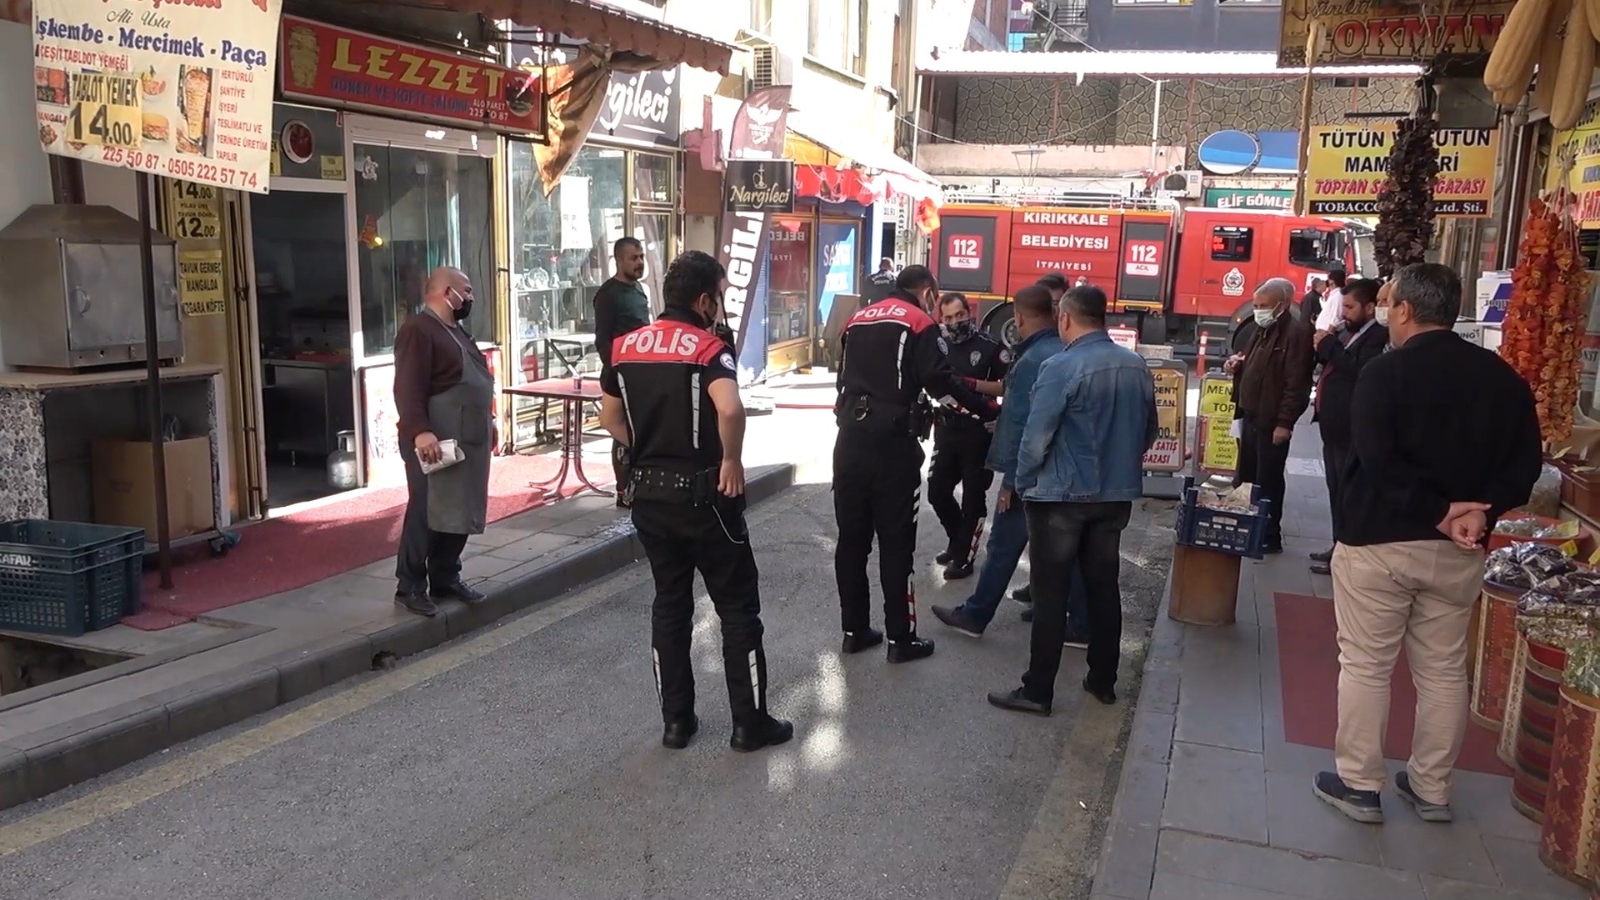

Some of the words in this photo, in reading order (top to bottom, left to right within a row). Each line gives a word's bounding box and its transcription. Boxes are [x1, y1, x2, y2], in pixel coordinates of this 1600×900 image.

[106, 8, 134, 24] Ali
[140, 10, 171, 29] Usta
[1307, 14, 1504, 57] OKMAN
[118, 27, 205, 58] Mercimek
[220, 39, 267, 70] Paça
[332, 38, 505, 97] LEZZET
[72, 74, 104, 103] TABLOT
[106, 77, 138, 107] YEMEK
[70, 102, 133, 146] 14.00
[253, 124, 263, 134] VE
[243, 137, 268, 151] ÜRETİM
[1319, 129, 1384, 148] TÜTÜN
[103, 146, 123, 163] 225
[126, 150, 143, 167] 50
[145, 154, 160, 170] 87
[168, 158, 195, 177] 0505
[196, 163, 217, 181] 222
[220, 168, 236, 185] 57
[240, 171, 258, 188] 74
[173, 179, 213, 199] 14.00
[1315, 178, 1368, 195] TOPTAN
[730, 185, 791, 209] Nargileci
[1217, 193, 1244, 208] ELİF
[1246, 193, 1291, 209] GÖMLE
[1463, 202, 1484, 215] Şti.
[1023, 211, 1109, 226] KIRIKKALE
[953, 239, 977, 256] 112
[1021, 234, 1109, 250] BELEDİYESİ
[1131, 245, 1157, 263] 112
[1036, 259, 1093, 271] İTFAİYESİ
[186, 279, 219, 292] MANGALDA
[854, 303, 908, 320] POLİS
[621, 327, 699, 356] POLİS
[1155, 440, 1178, 454] SATIŞ
